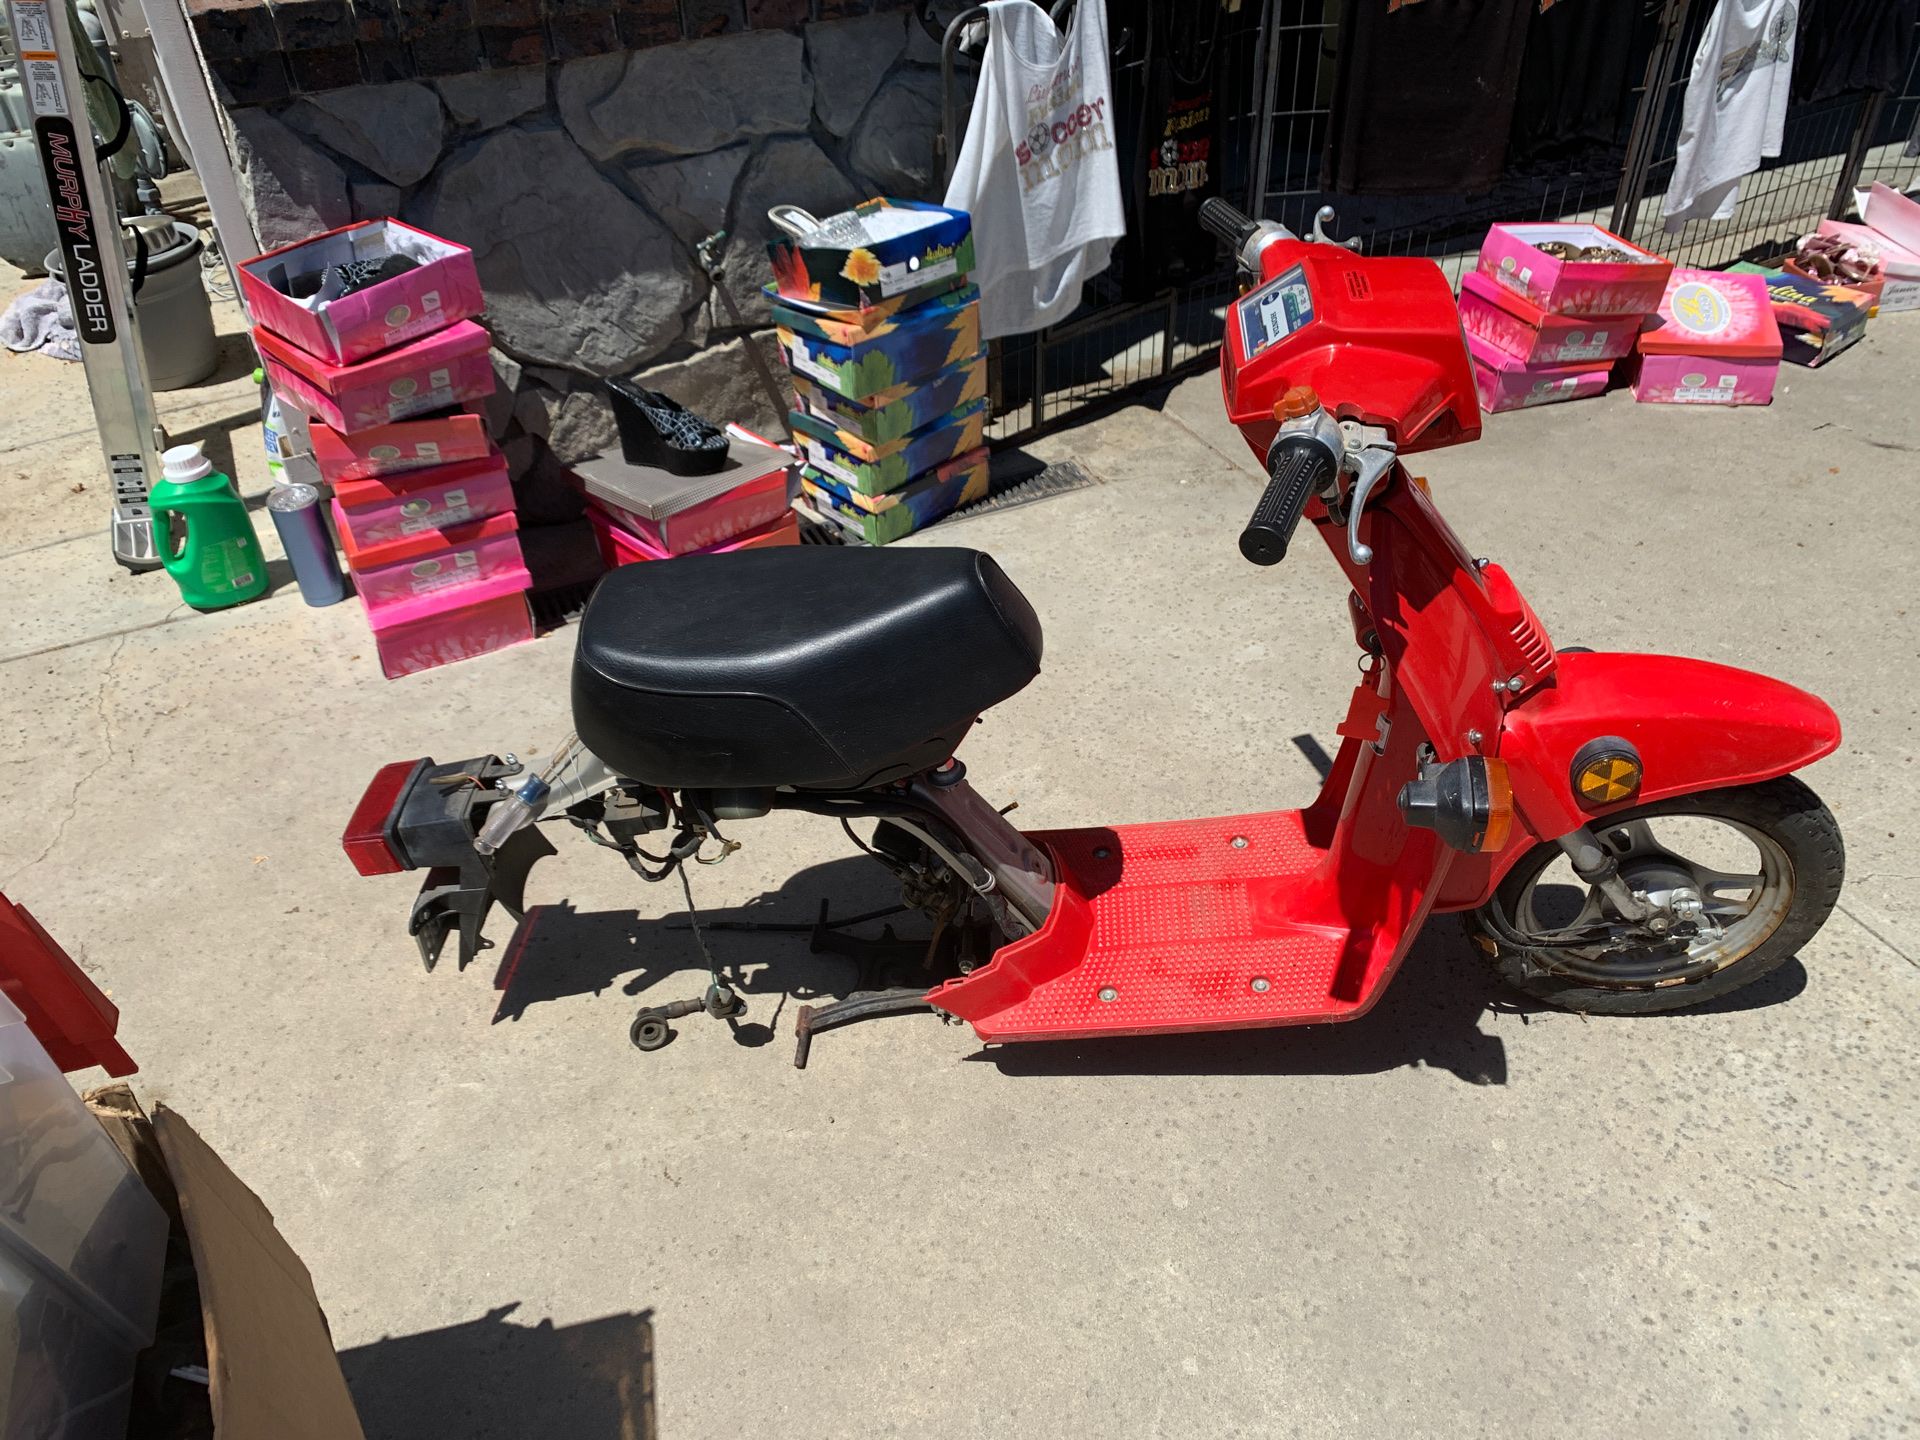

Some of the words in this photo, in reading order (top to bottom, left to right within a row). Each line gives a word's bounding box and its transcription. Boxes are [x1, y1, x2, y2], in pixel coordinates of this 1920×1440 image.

[47, 132, 91, 241] MURPHY
[73, 244, 109, 332] LADDER
[1270, 311, 1280, 337] HONDA
